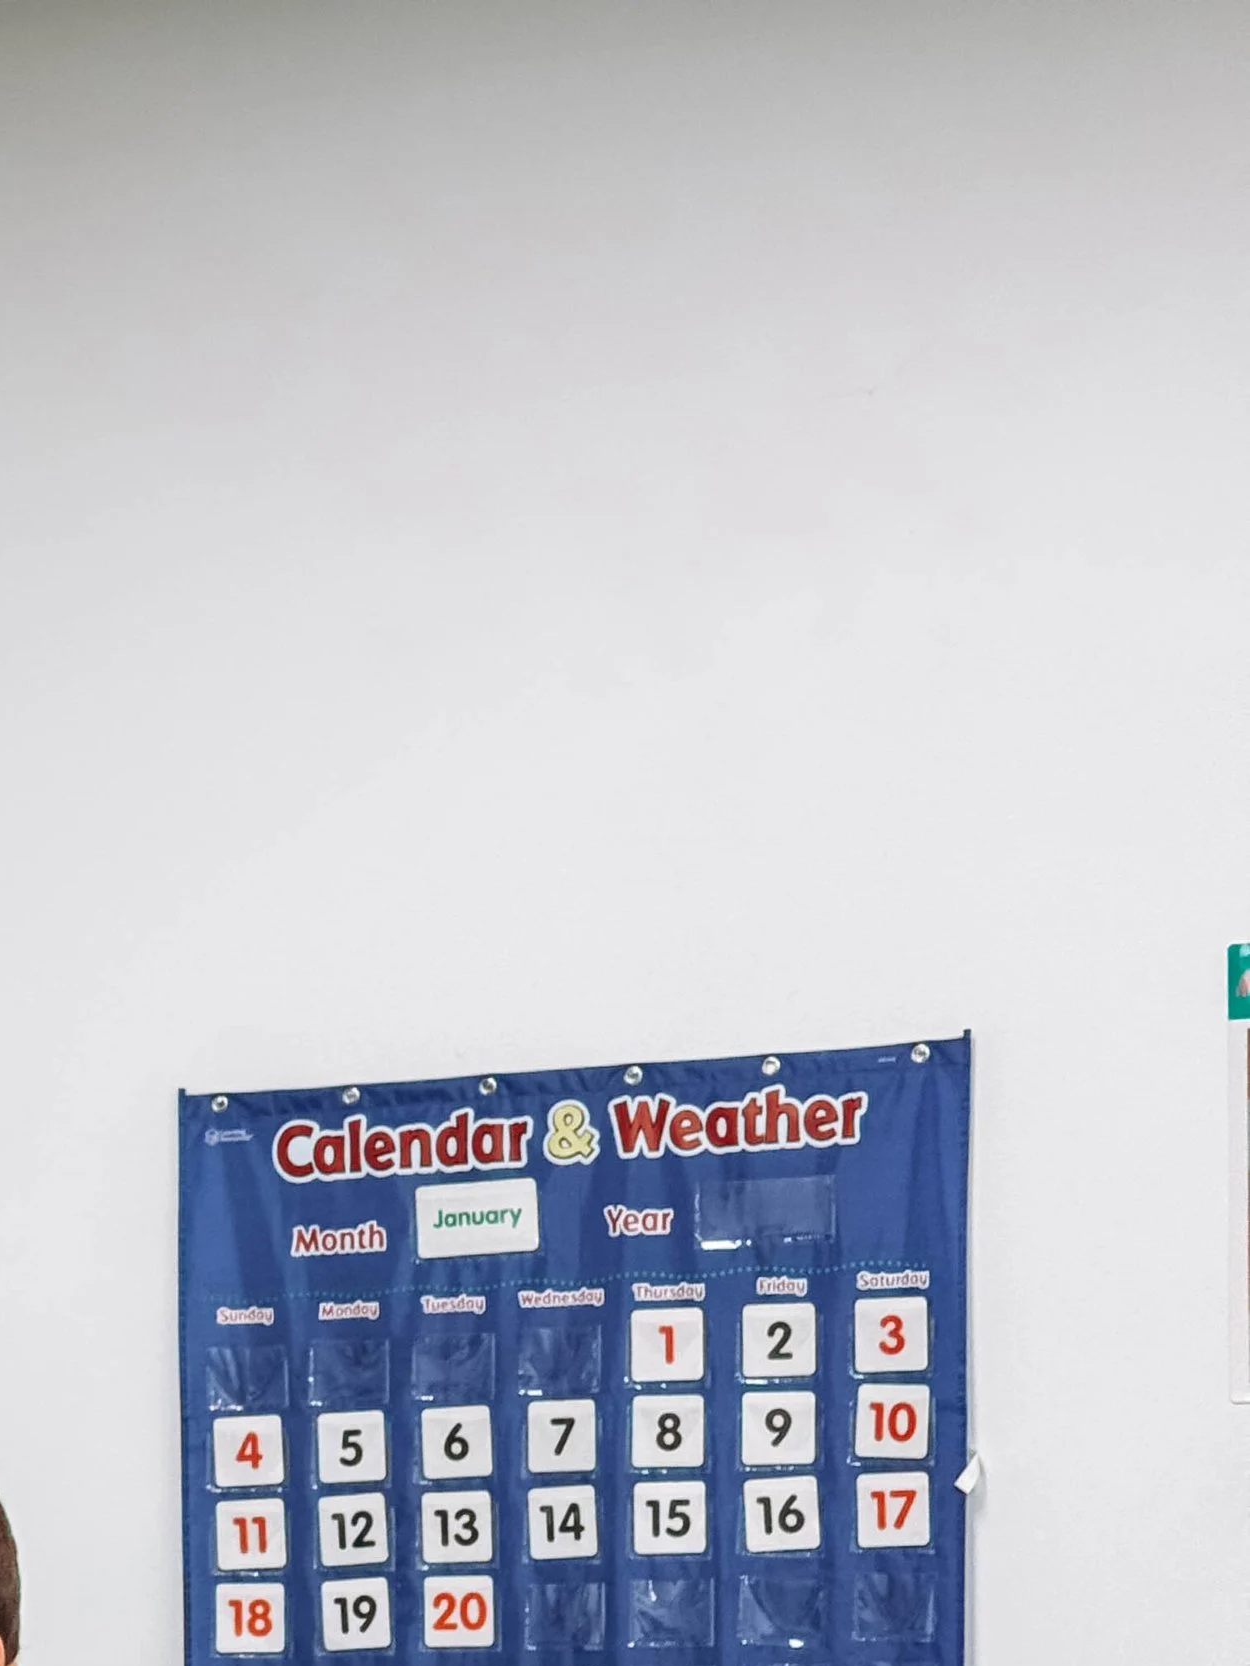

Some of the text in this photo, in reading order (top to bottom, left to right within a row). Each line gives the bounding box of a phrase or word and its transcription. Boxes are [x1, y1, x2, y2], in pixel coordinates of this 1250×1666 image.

[275, 1087, 865, 1179] Calendar & Weather
[294, 1224, 386, 1252] Month
[433, 1208, 522, 1228] January
[606, 1207, 671, 1234] Year
[219, 1272, 929, 1325] Sunday Monday Tuesday Wednesday Thursday Friday Saturday
[658, 1315, 905, 1364] 1 2 3
[236, 1402, 918, 1469] 4 5 6 7 8 9 10
[232, 1490, 918, 1554] 11 12 13 14 15 16 17
[228, 1592, 487, 1637] 18 19 20
